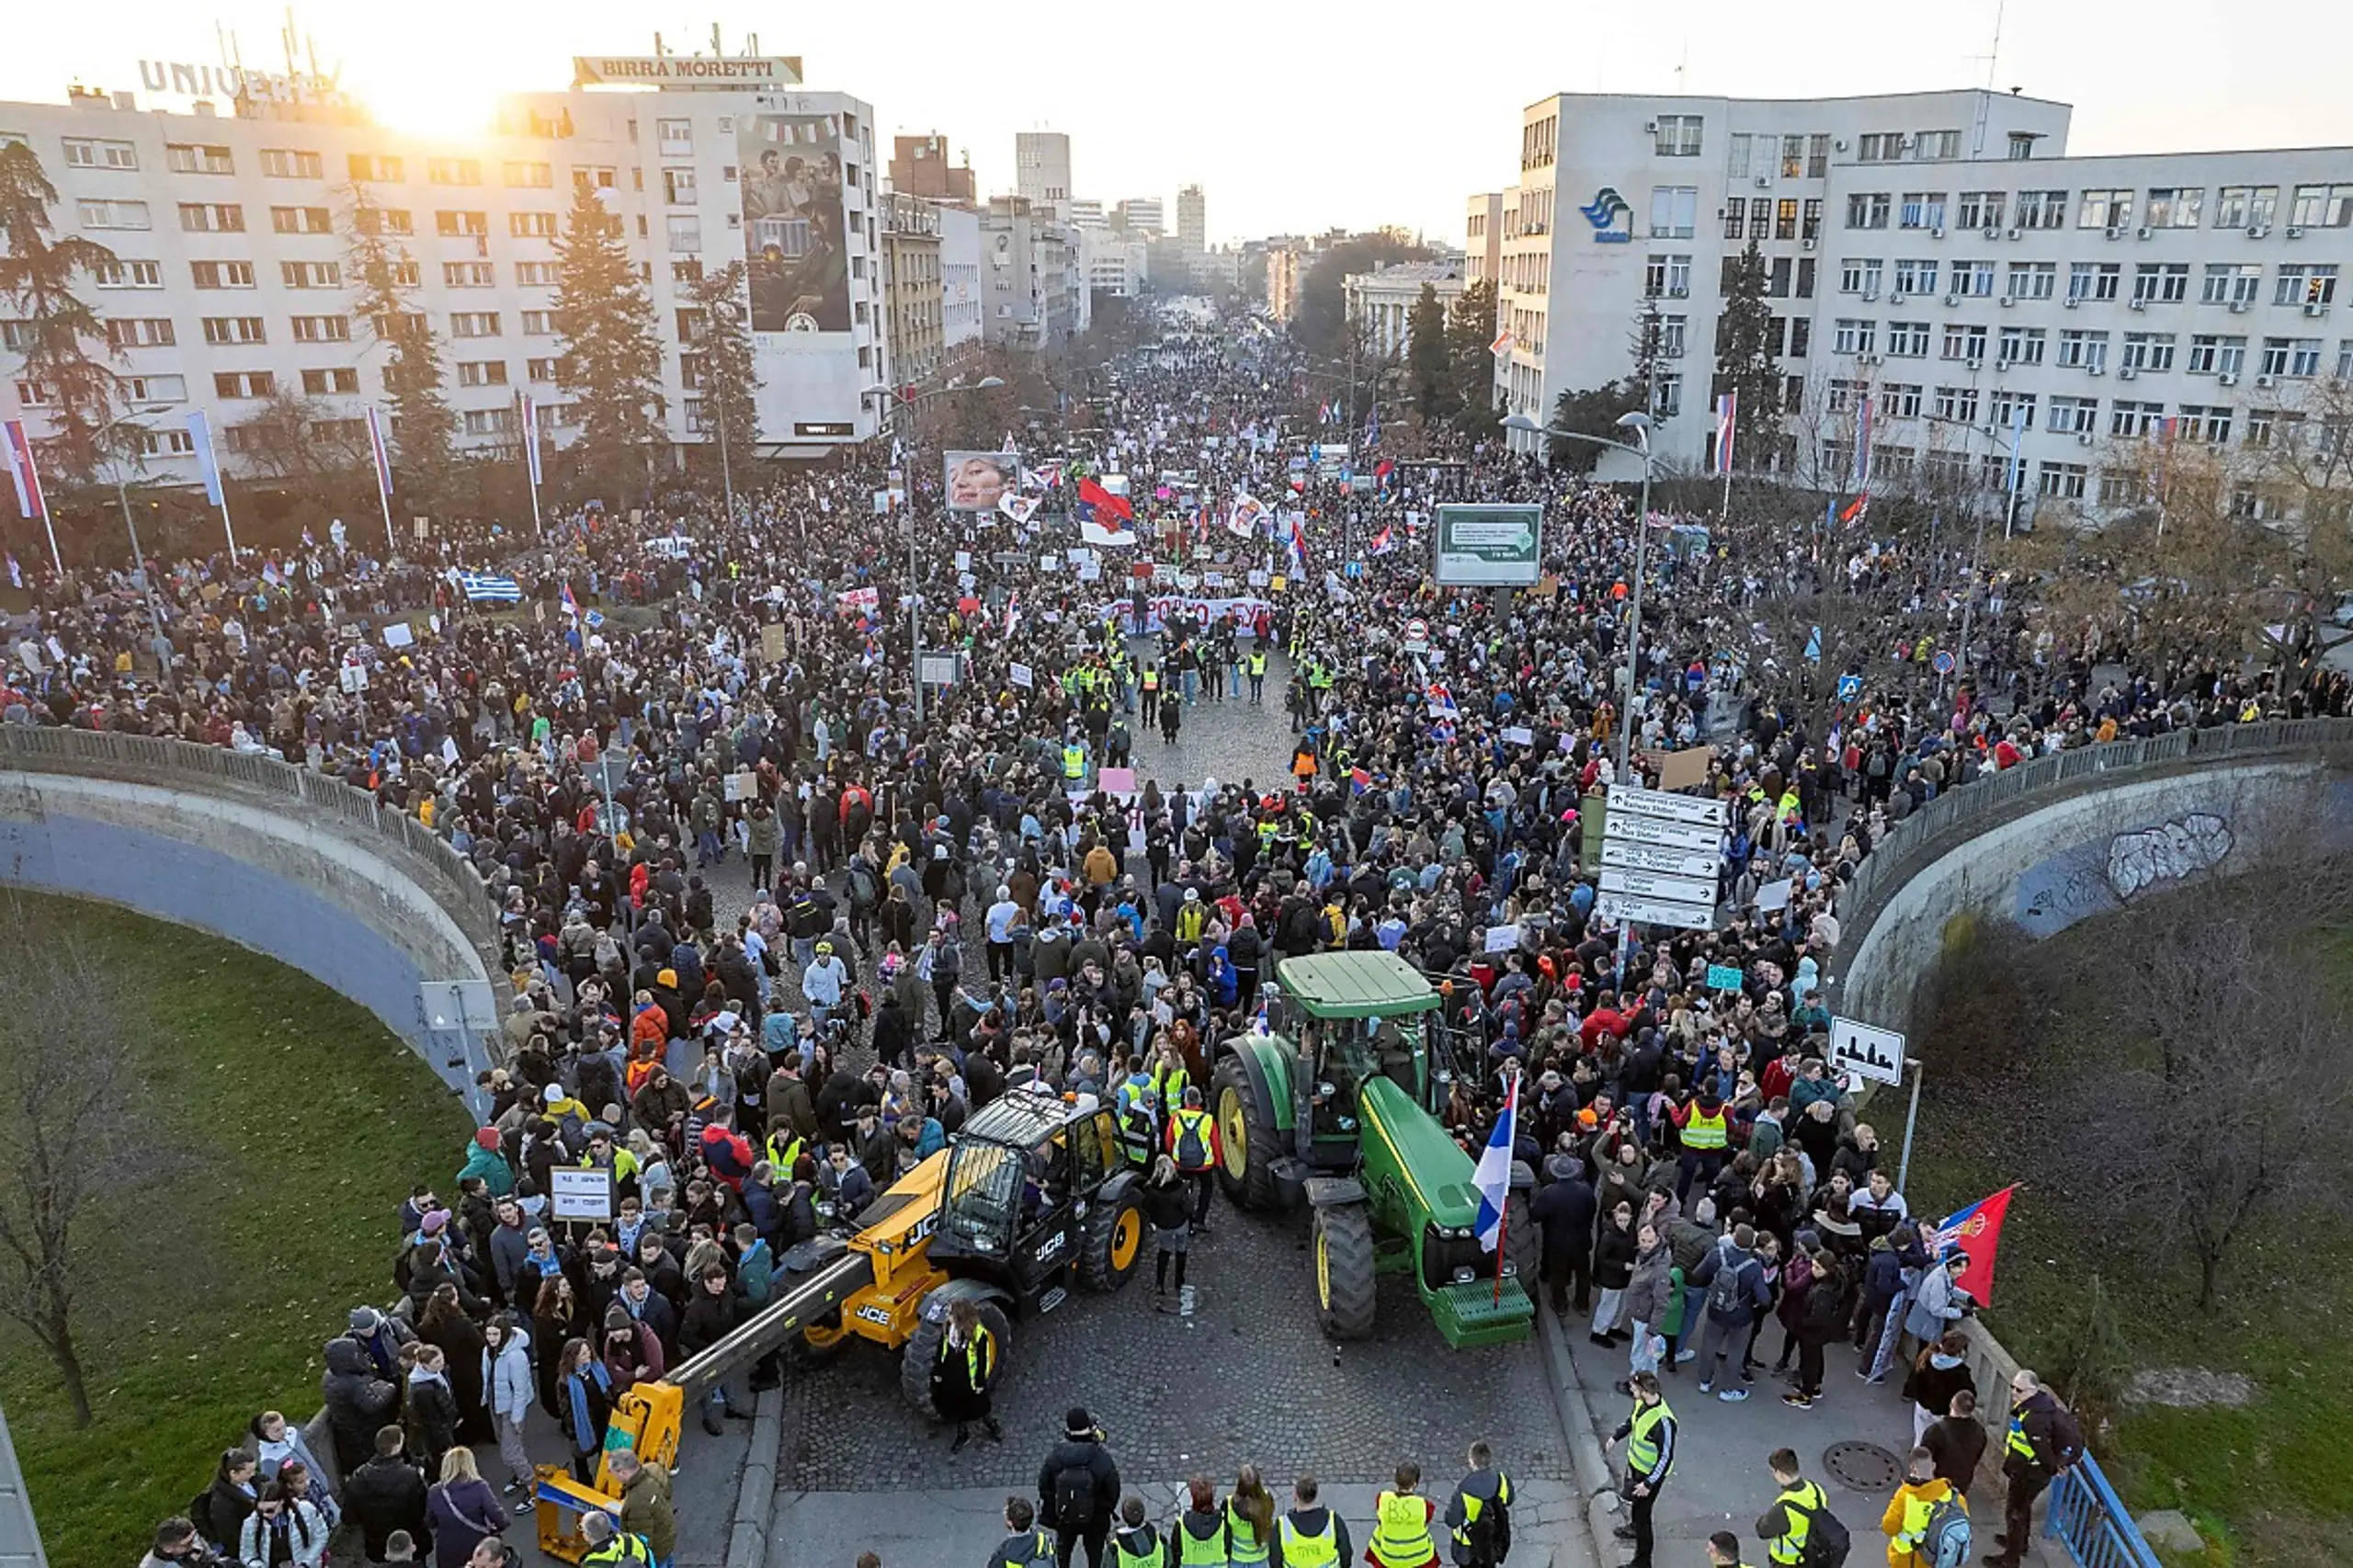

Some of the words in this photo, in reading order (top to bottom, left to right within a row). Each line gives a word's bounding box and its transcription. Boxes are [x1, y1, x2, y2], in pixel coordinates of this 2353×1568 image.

[602, 61, 670, 77] BIRRA
[676, 61, 774, 77] MORETTI
[910, 1212, 939, 1245] JC
[1035, 1231, 1064, 1261] JCB
